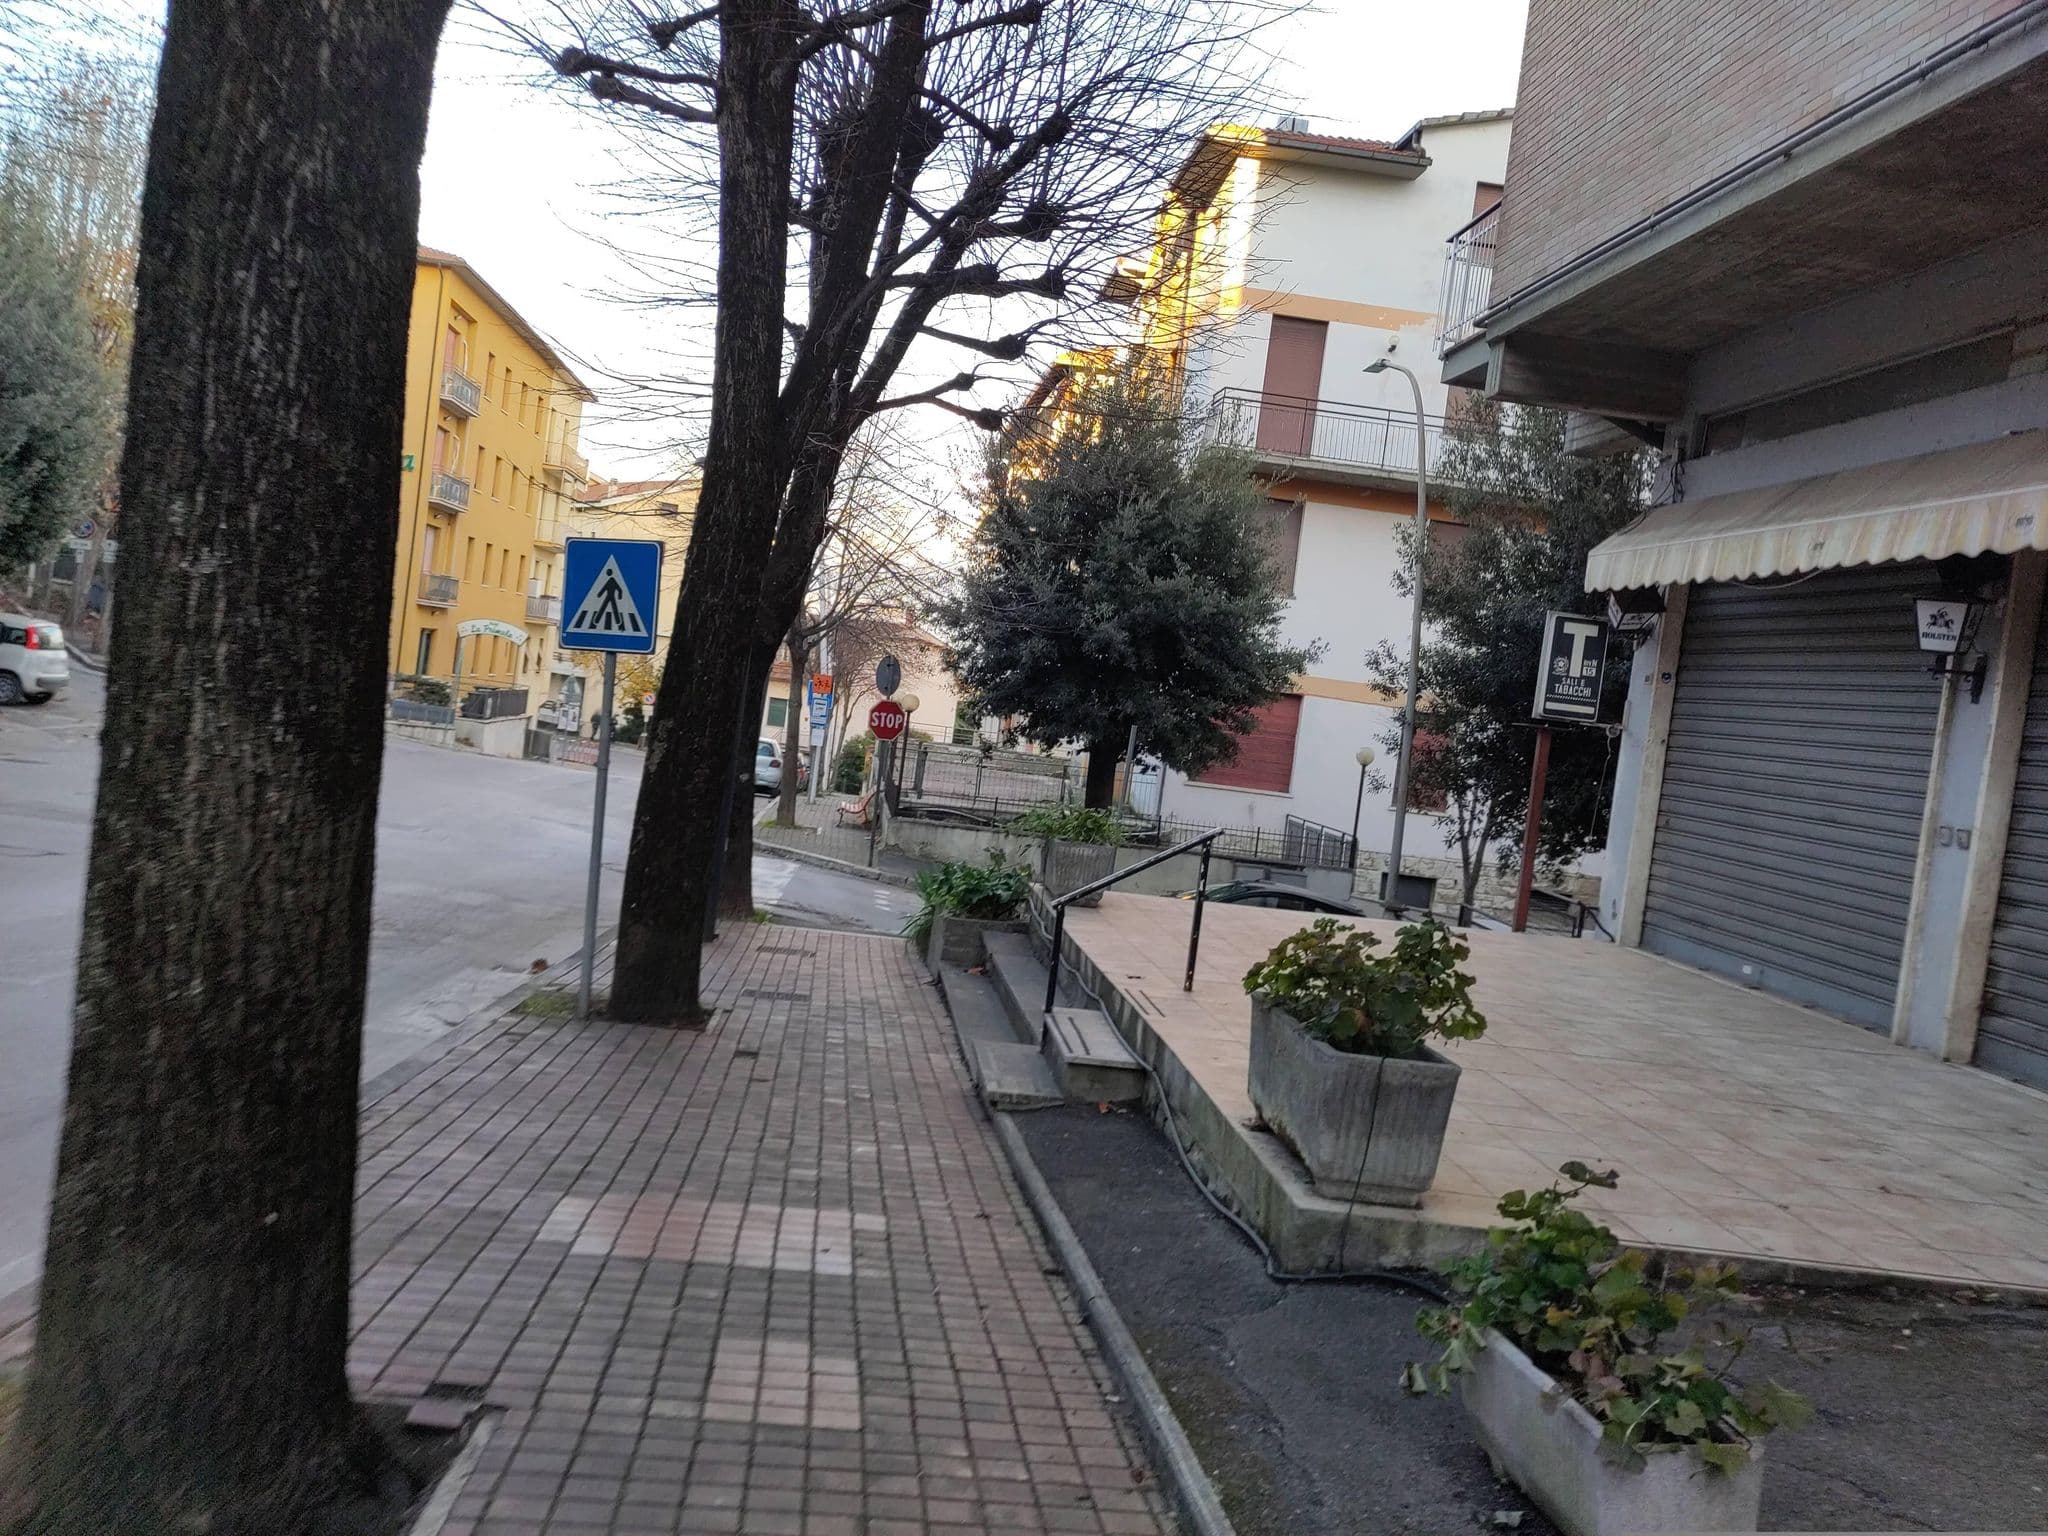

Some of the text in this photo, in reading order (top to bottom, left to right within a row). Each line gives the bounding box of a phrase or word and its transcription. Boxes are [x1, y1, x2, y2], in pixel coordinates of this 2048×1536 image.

[1564, 621, 1599, 678] T
[1554, 684, 1592, 697] TABACCHI
[871, 712, 903, 729] STOP
